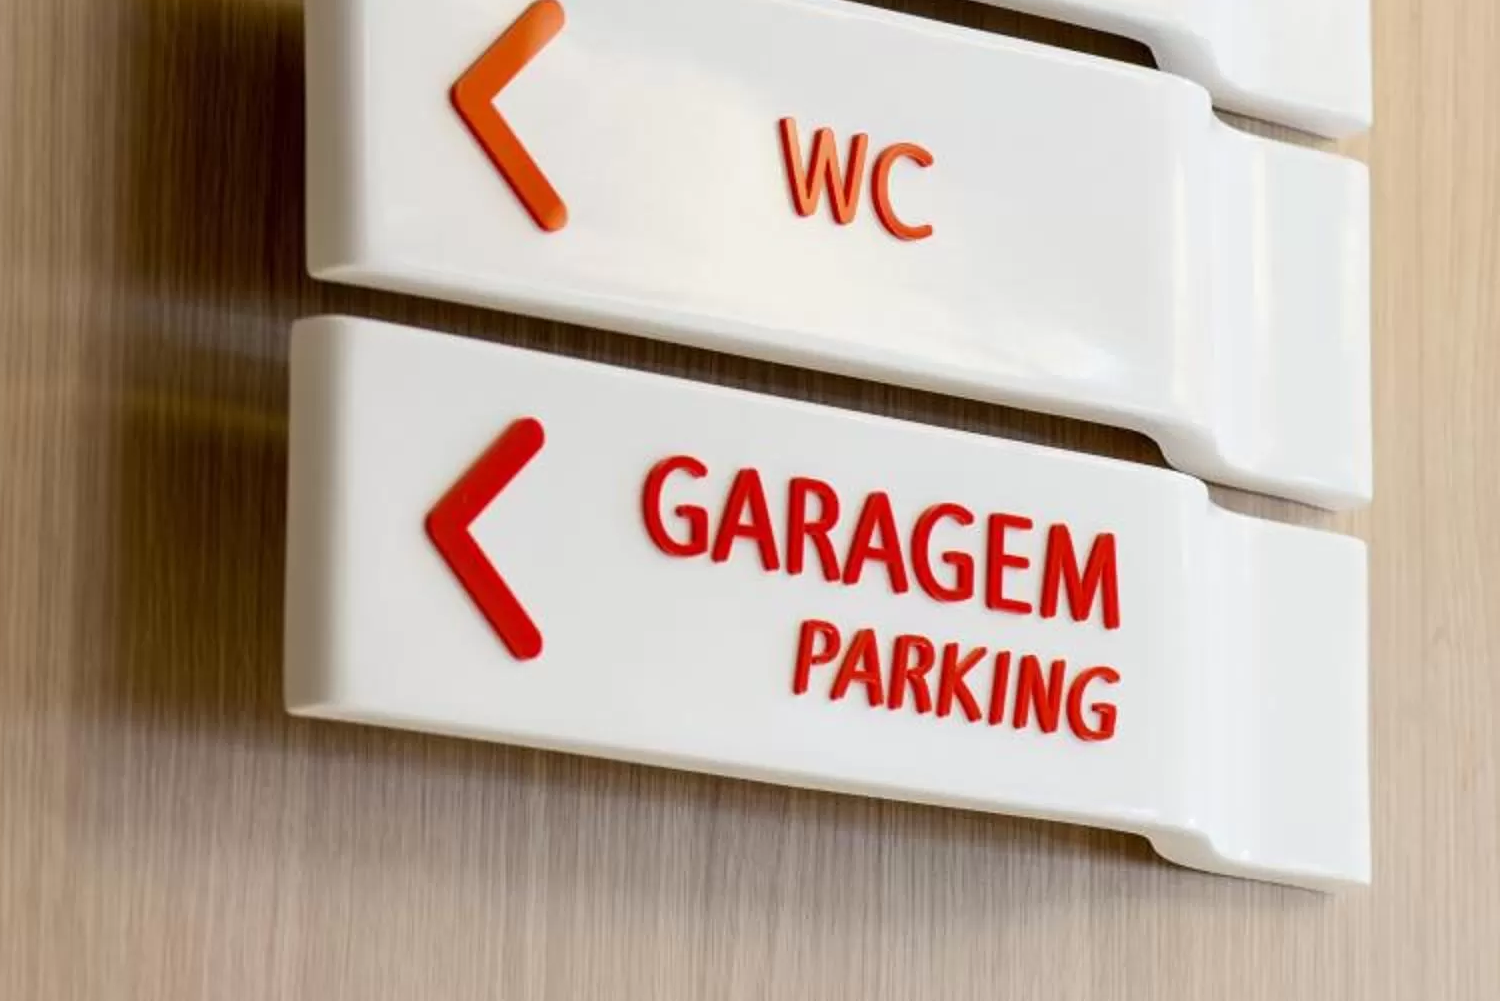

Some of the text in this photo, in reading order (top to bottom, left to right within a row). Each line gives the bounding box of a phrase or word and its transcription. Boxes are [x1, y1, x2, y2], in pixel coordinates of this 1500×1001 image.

[778, 117, 935, 241] WC
[640, 455, 1121, 631] GARAGEM
[792, 619, 1121, 742] PARKING
